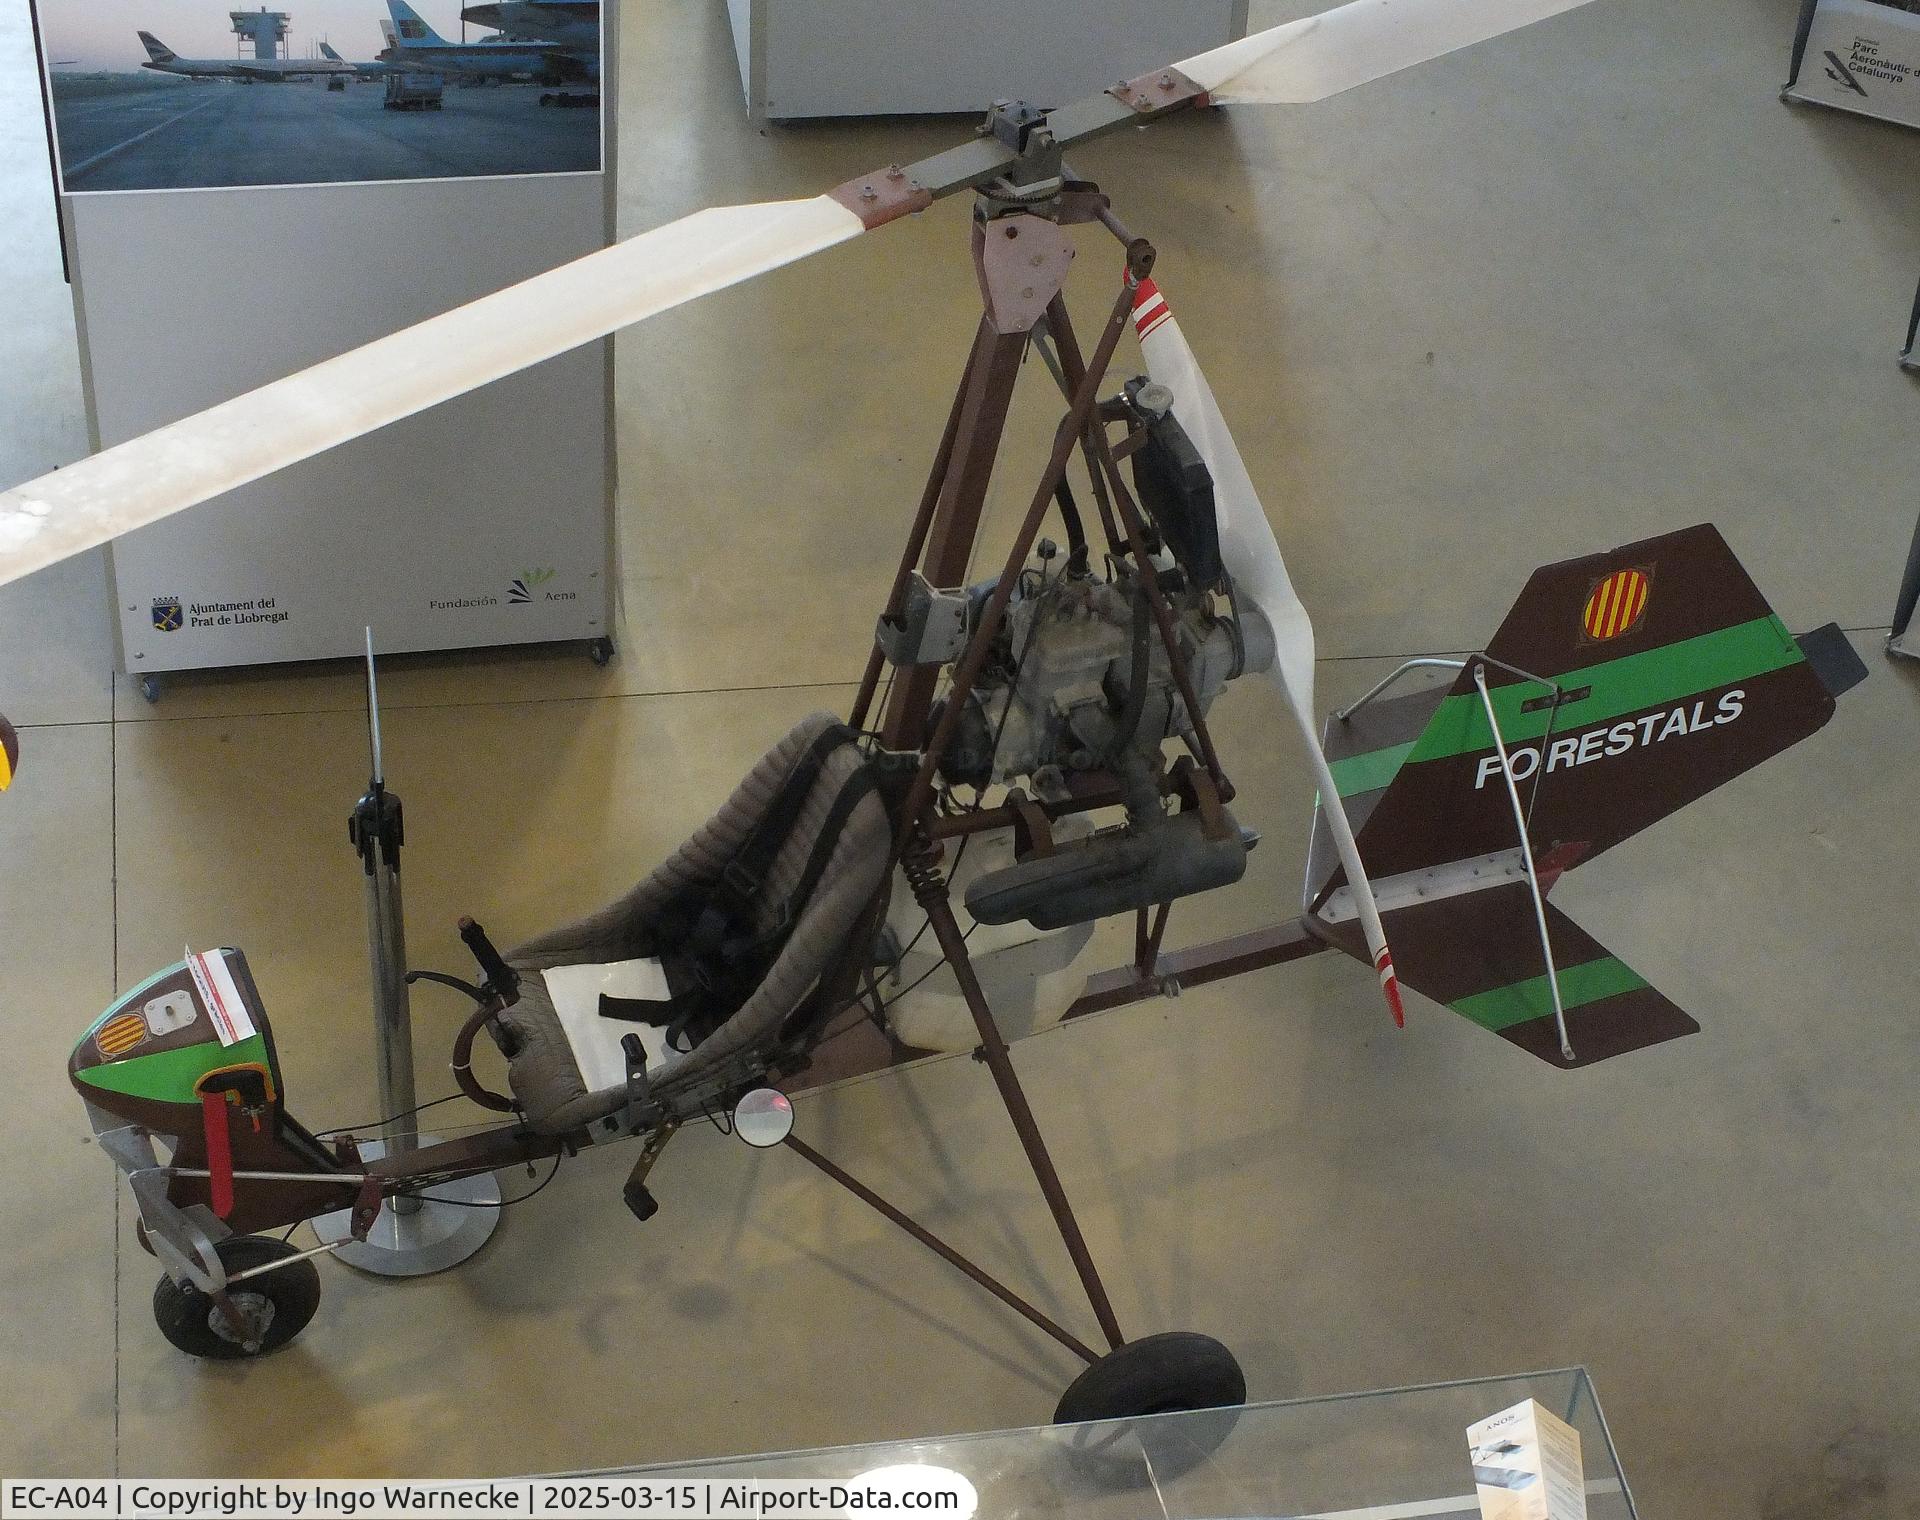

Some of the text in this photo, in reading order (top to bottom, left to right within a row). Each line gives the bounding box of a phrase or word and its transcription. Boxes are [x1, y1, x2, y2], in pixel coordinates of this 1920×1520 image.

[1853, 41, 1878, 55] Parc
[1848, 62, 1903, 83] Catalunya
[189, 597, 275, 616] Ajuntament del
[430, 592, 576, 610] Fundación Aena
[191, 611, 289, 628] Prat de Llobregat
[1474, 689, 1746, 790] FORESTALS
